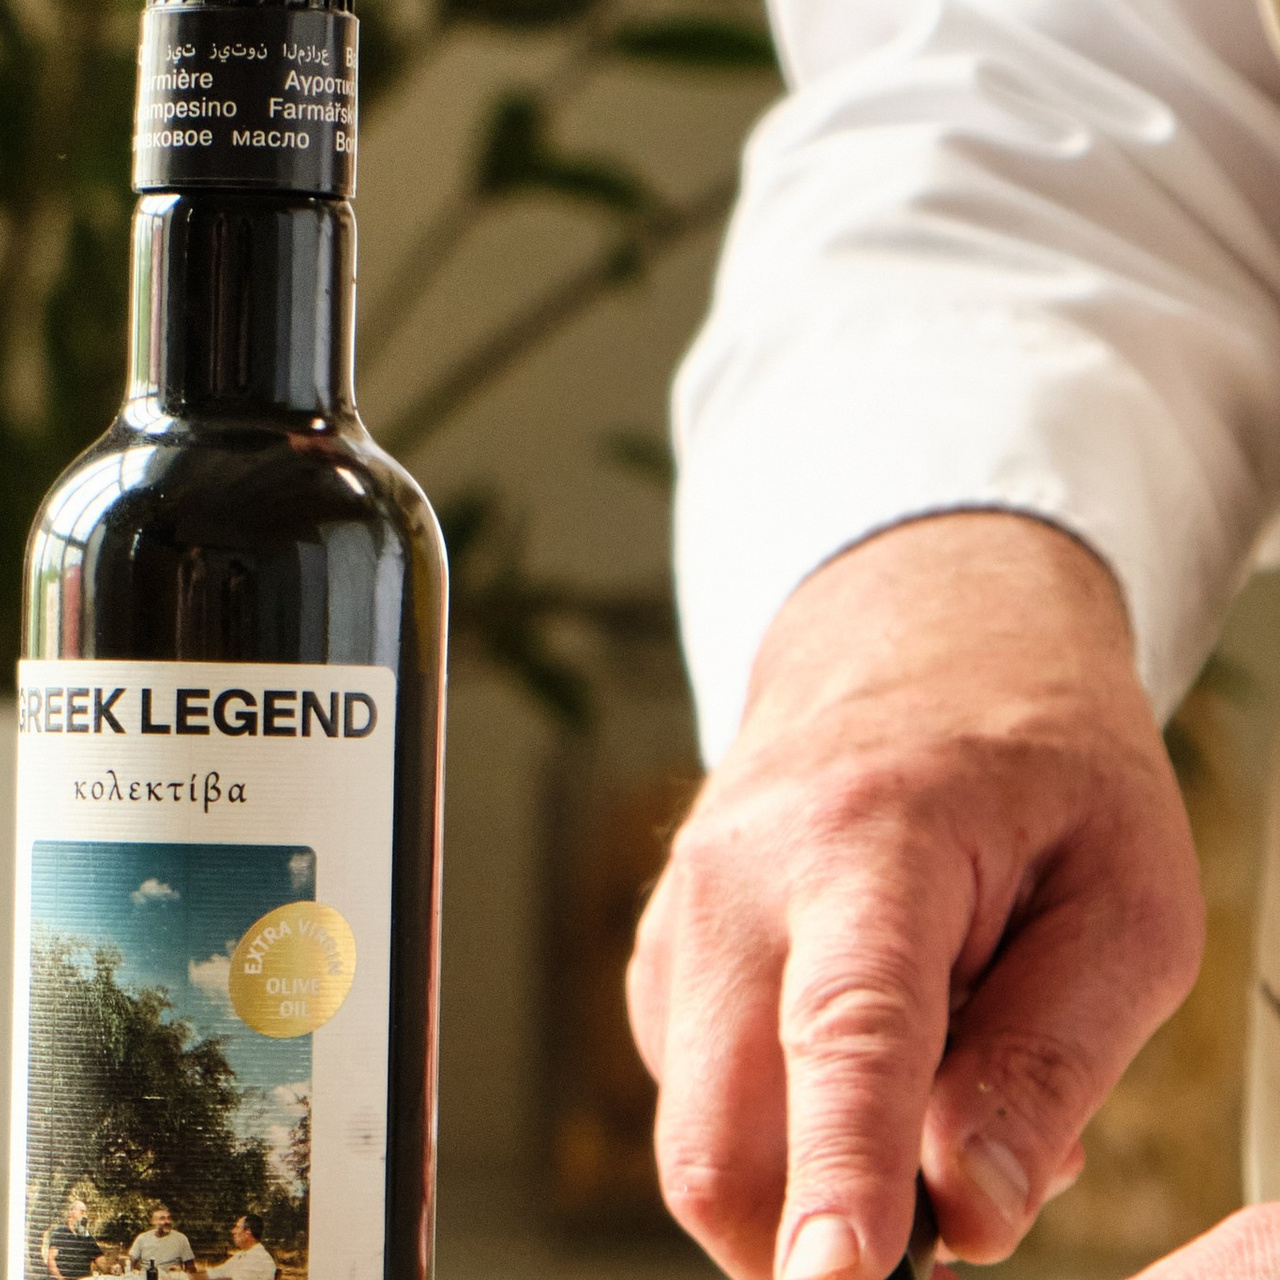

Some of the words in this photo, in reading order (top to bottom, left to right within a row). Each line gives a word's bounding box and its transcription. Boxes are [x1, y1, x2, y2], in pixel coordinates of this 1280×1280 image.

[232, 130, 310, 149] масло
[141, 688, 378, 738] LEGEND
[74, 770, 248, 813] κολεκτίβα
[244, 920, 293, 975] EXTRA
[266, 977, 321, 995] OLIVE
[280, 1000, 311, 1018] OIL
